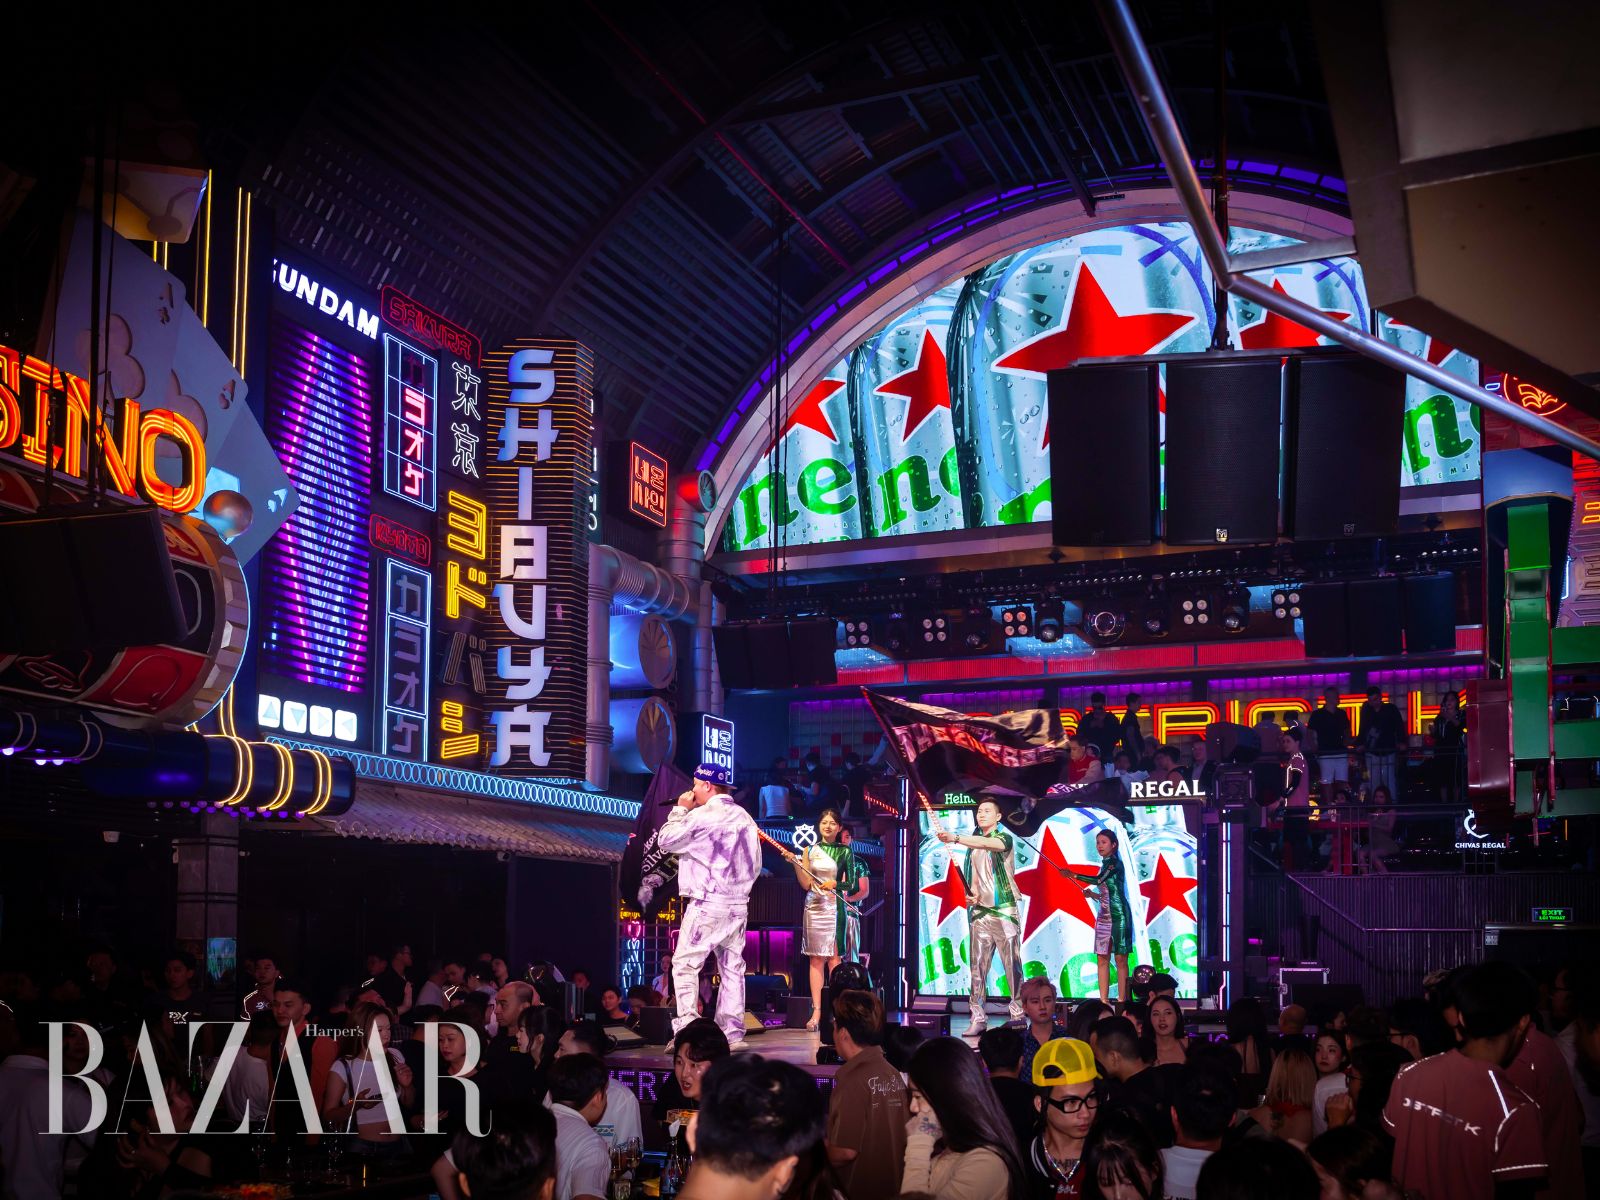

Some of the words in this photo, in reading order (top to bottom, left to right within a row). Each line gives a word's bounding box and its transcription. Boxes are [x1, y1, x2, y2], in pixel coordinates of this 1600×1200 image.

[389, 296, 472, 361] SAKURA
[451, 361, 482, 479] 東京
[374, 518, 428, 562] KYOTO
[394, 573, 422, 754] カラオケ
[1130, 779, 1206, 798] REGAL
[641, 849, 669, 872] Silve
